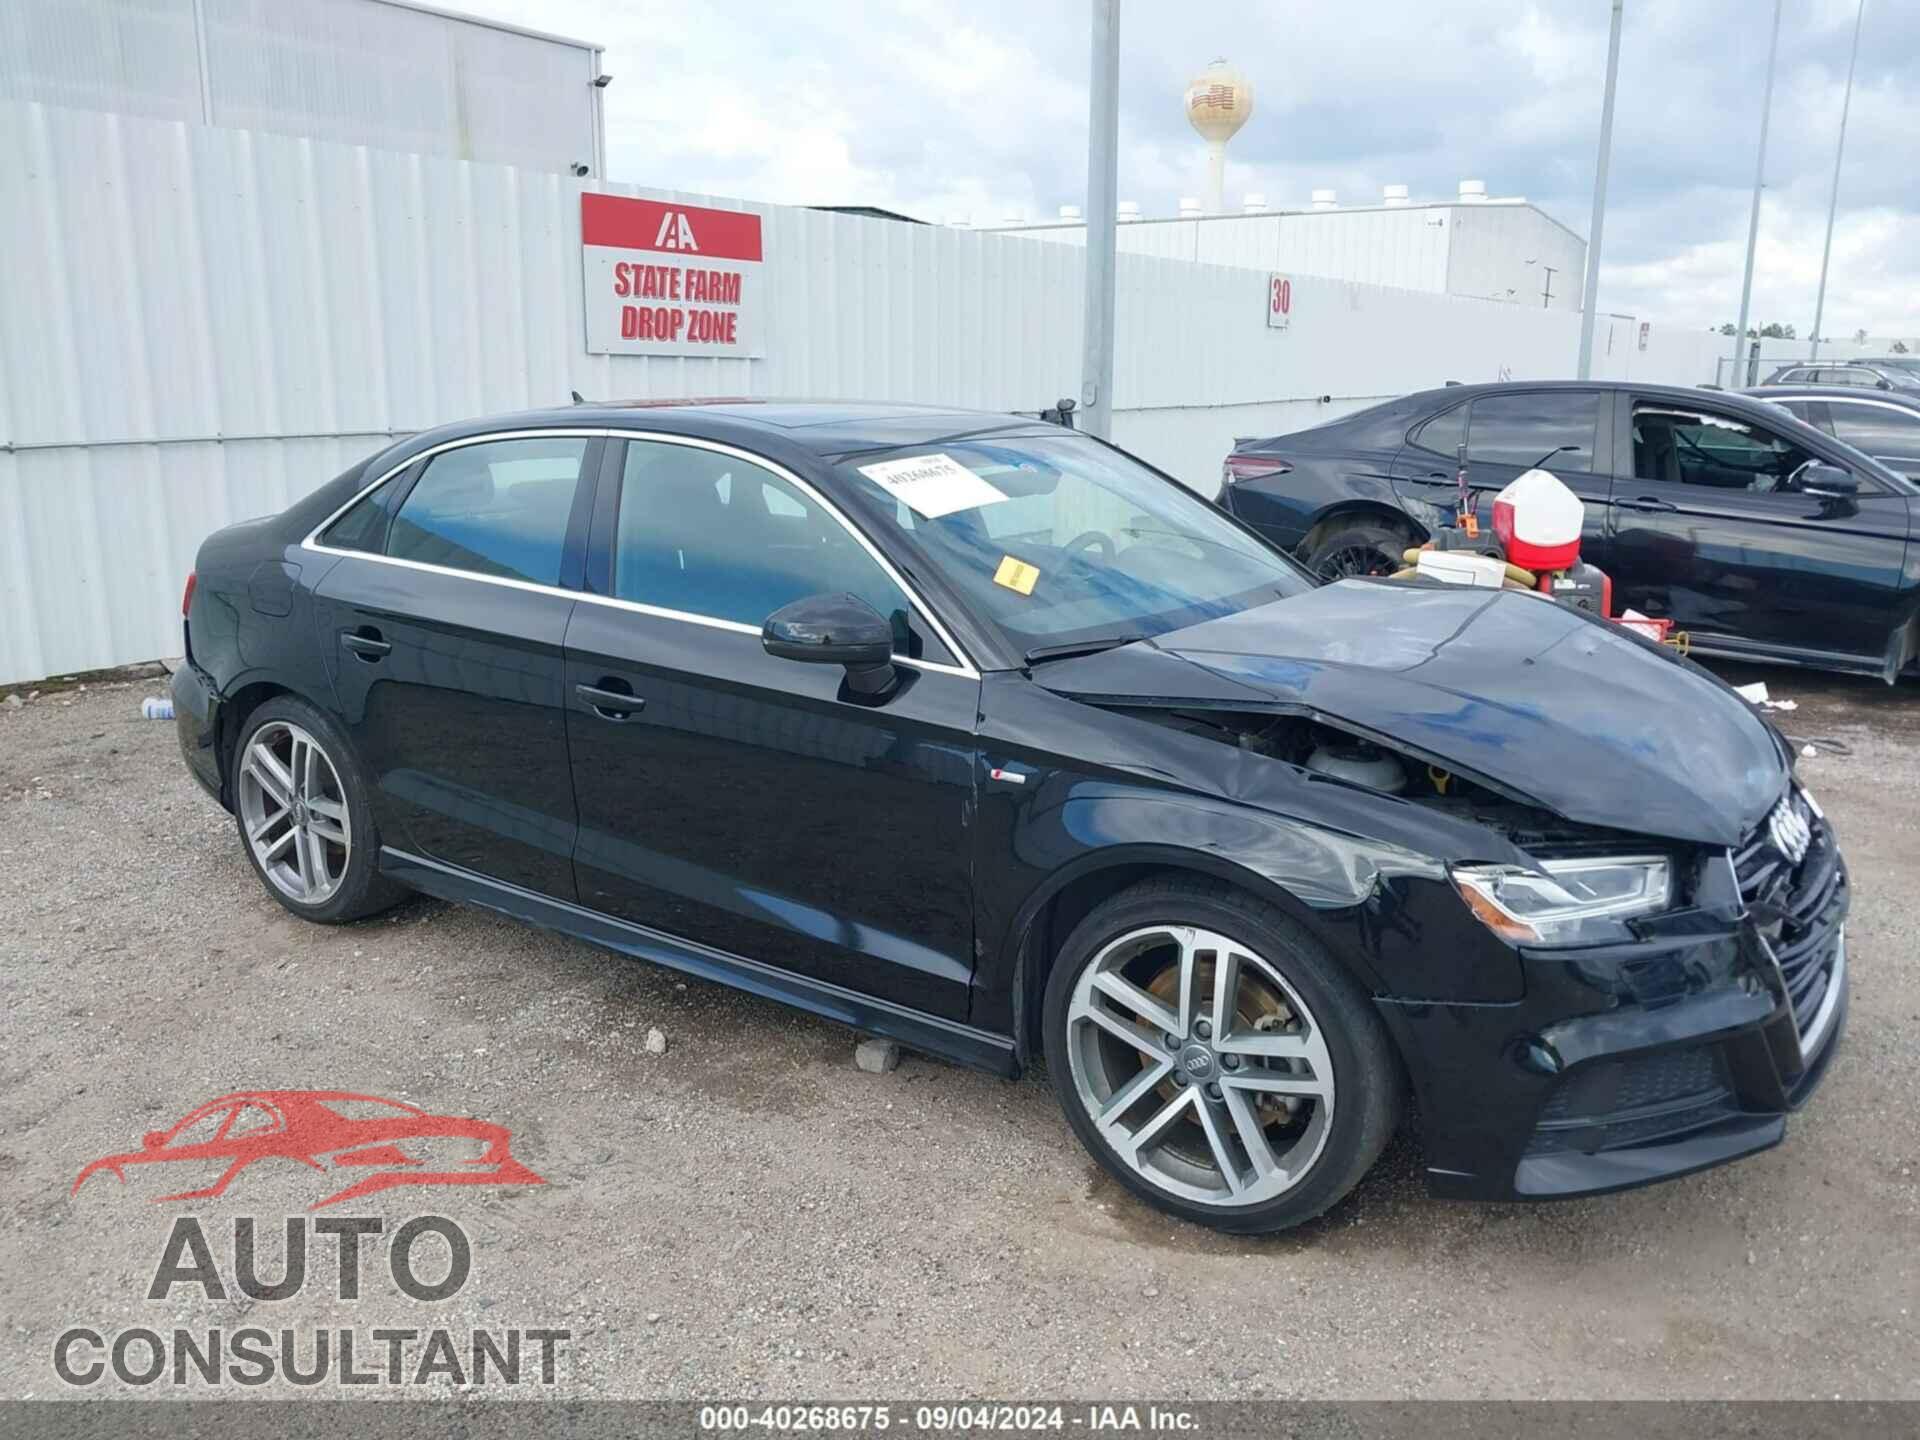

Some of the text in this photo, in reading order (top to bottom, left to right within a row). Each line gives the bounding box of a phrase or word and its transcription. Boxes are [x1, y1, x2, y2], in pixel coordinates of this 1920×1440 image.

[614, 262, 742, 305] STATE FARM
[1272, 277, 1291, 315] 30
[621, 305, 737, 344] DROP ZONE
